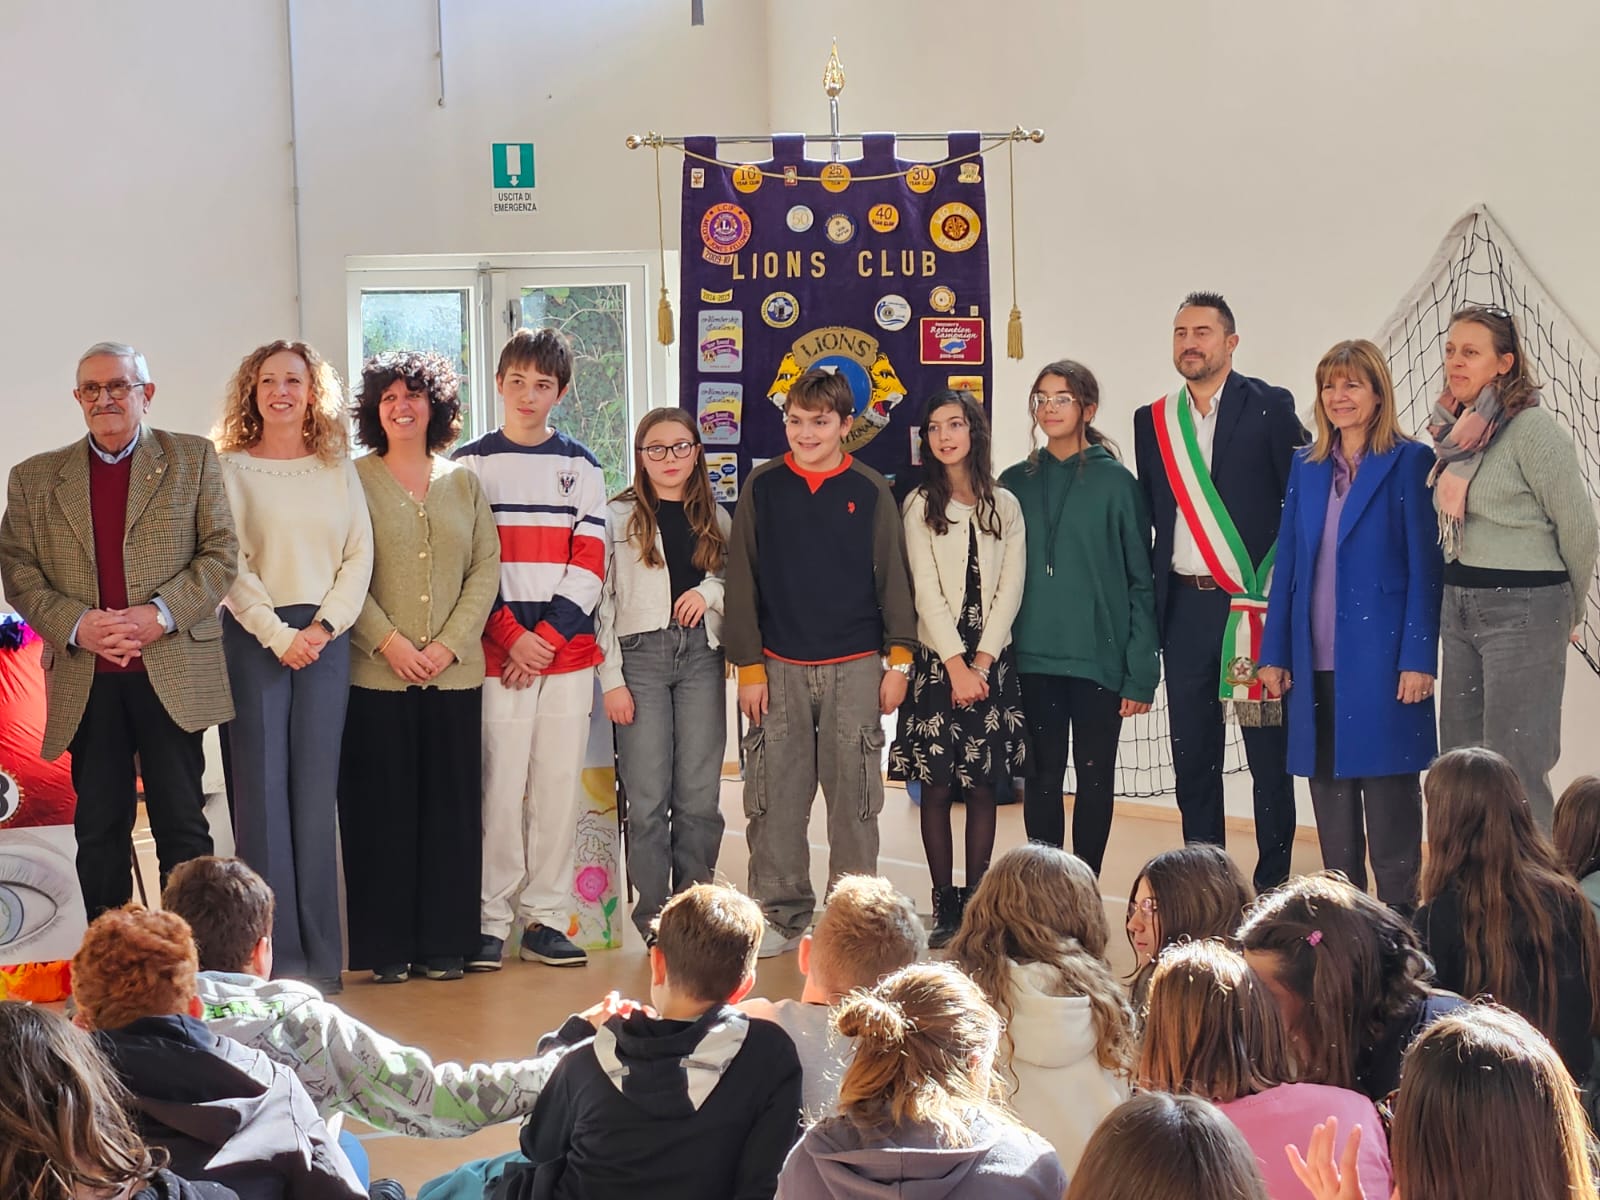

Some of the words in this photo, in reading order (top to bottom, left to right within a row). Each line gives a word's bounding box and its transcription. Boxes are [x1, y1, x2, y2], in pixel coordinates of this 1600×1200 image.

[741, 167, 756, 180] 10
[829, 166, 843, 175] 25
[912, 167, 930, 181] 30
[498, 192, 523, 201] USCITA
[525, 192, 532, 201] DI
[494, 203, 537, 212] EMERGENZA
[876, 207, 892, 220] 40
[732, 251, 826, 280] LIONS
[857, 249, 937, 278] CLUB
[930, 326, 972, 334] Retention
[935, 331, 978, 341] Campaign
[800, 333, 871, 357] LIONS
